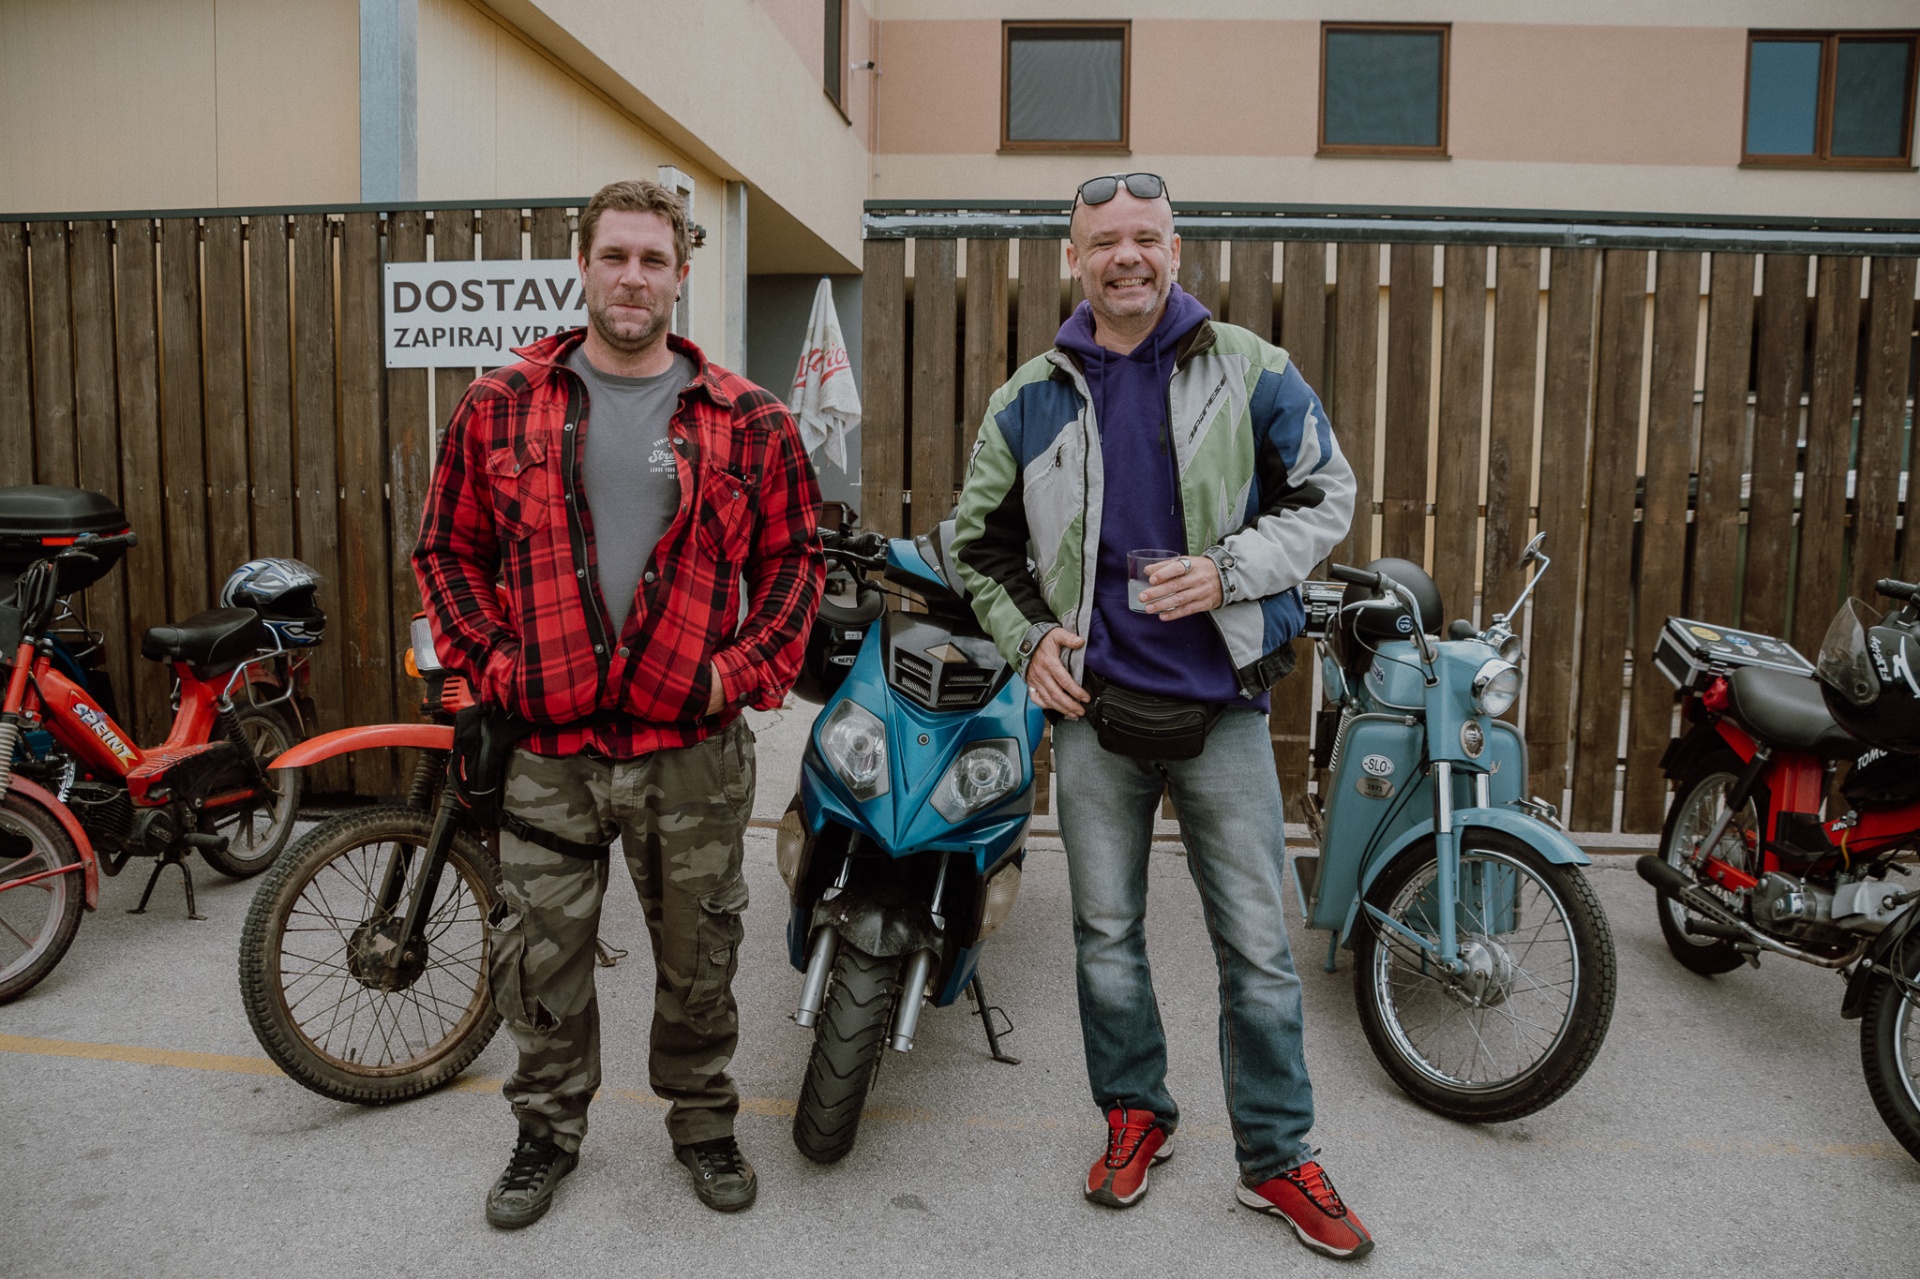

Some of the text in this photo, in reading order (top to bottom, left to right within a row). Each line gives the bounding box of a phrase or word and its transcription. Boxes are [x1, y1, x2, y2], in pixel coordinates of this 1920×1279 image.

[393, 326, 587, 352] ZAPIRAJ VR
[72, 703, 131, 757] SPRINT
[1368, 758, 1387, 773] SLO
